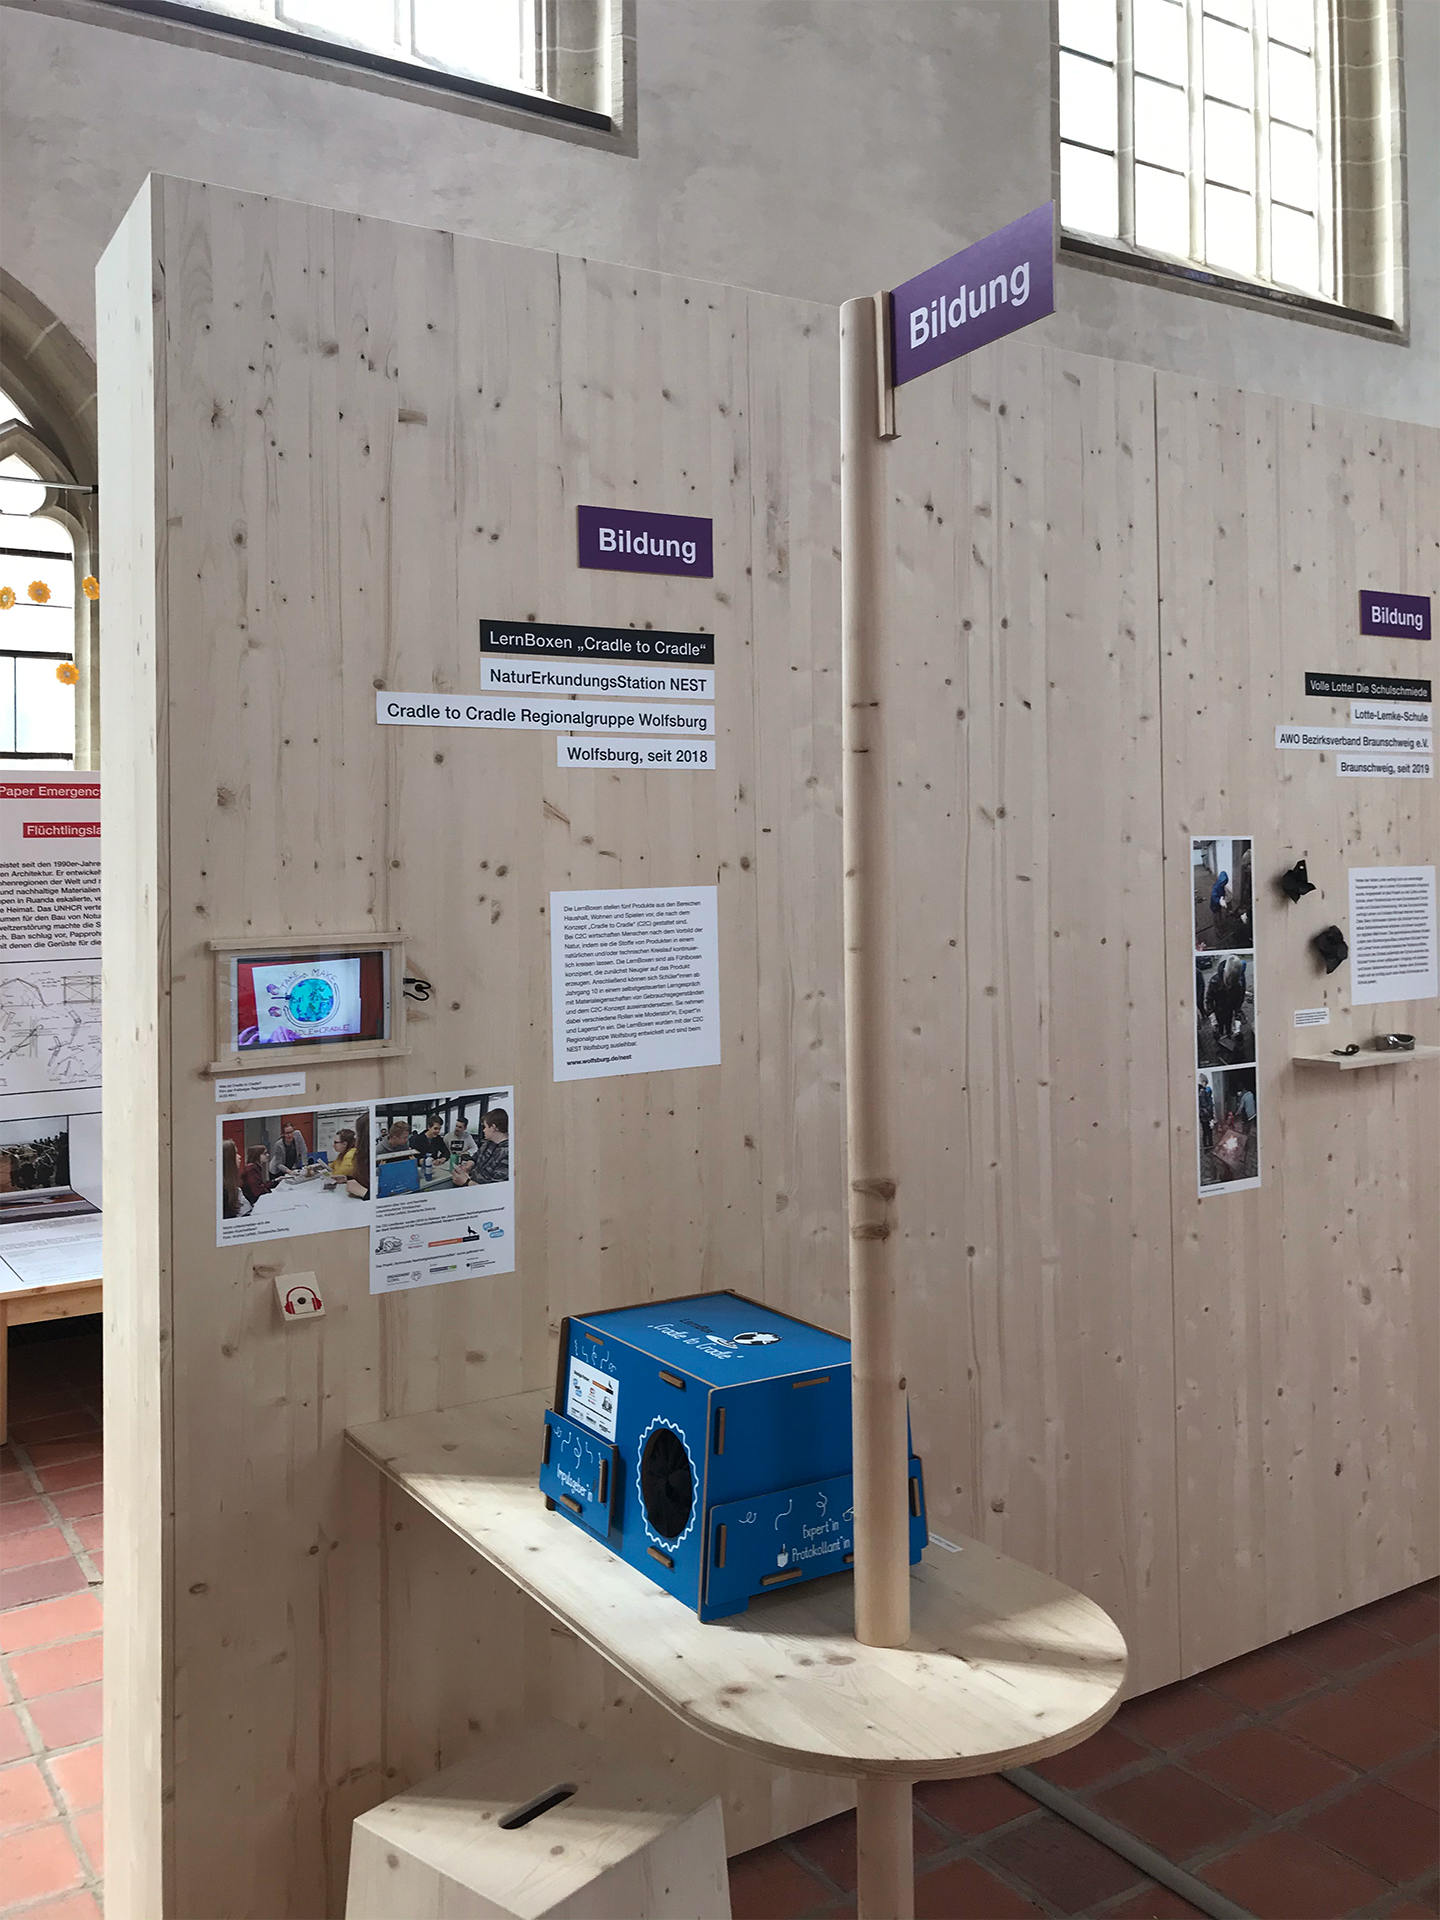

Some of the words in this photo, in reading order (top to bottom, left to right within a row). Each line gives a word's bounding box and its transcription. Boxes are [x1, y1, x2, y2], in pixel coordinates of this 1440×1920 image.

[910, 262, 1030, 349] Bildung
[599, 528, 696, 564] Bildung
[1372, 606, 1423, 630] Bildung
[490, 631, 573, 648] LernBoxen
[635, 640, 650, 653] to
[490, 669, 665, 691] NaturErkundungsStation
[668, 678, 707, 692] NEST
[1310, 680, 1330, 691] Volle
[1332, 682, 1355, 692] Lotte!
[1356, 683, 1370, 694] Die
[1372, 684, 1428, 697] Schulschmiede
[387, 703, 441, 719] Cradle
[445, 706, 460, 720] to
[465, 706, 516, 722] Cradle
[520, 708, 635, 729] Regionalgruppe
[638, 714, 707, 732] Wolfsburg
[1355, 710, 1428, 722] Lotte-Lemke-Schule
[1280, 733, 1301, 744] AWO
[1303, 734, 1362, 746] Bezirksverband
[1363, 737, 1414, 750] Braunschweig
[1415, 739, 1428, 748] e.V.
[567, 747, 643, 764] Wolfsburg,
[647, 749, 671, 762] seit
[674, 750, 708, 763] 2018
[1340, 762, 1396, 775] Braunschweig,
[1397, 764, 1410, 773] seit
[1412, 764, 1430, 774] 2019
[0, 787, 34, 797] Paper
[39, 786, 101, 798] Emergenc
[16, 887, 58, 895] nachhaltige
